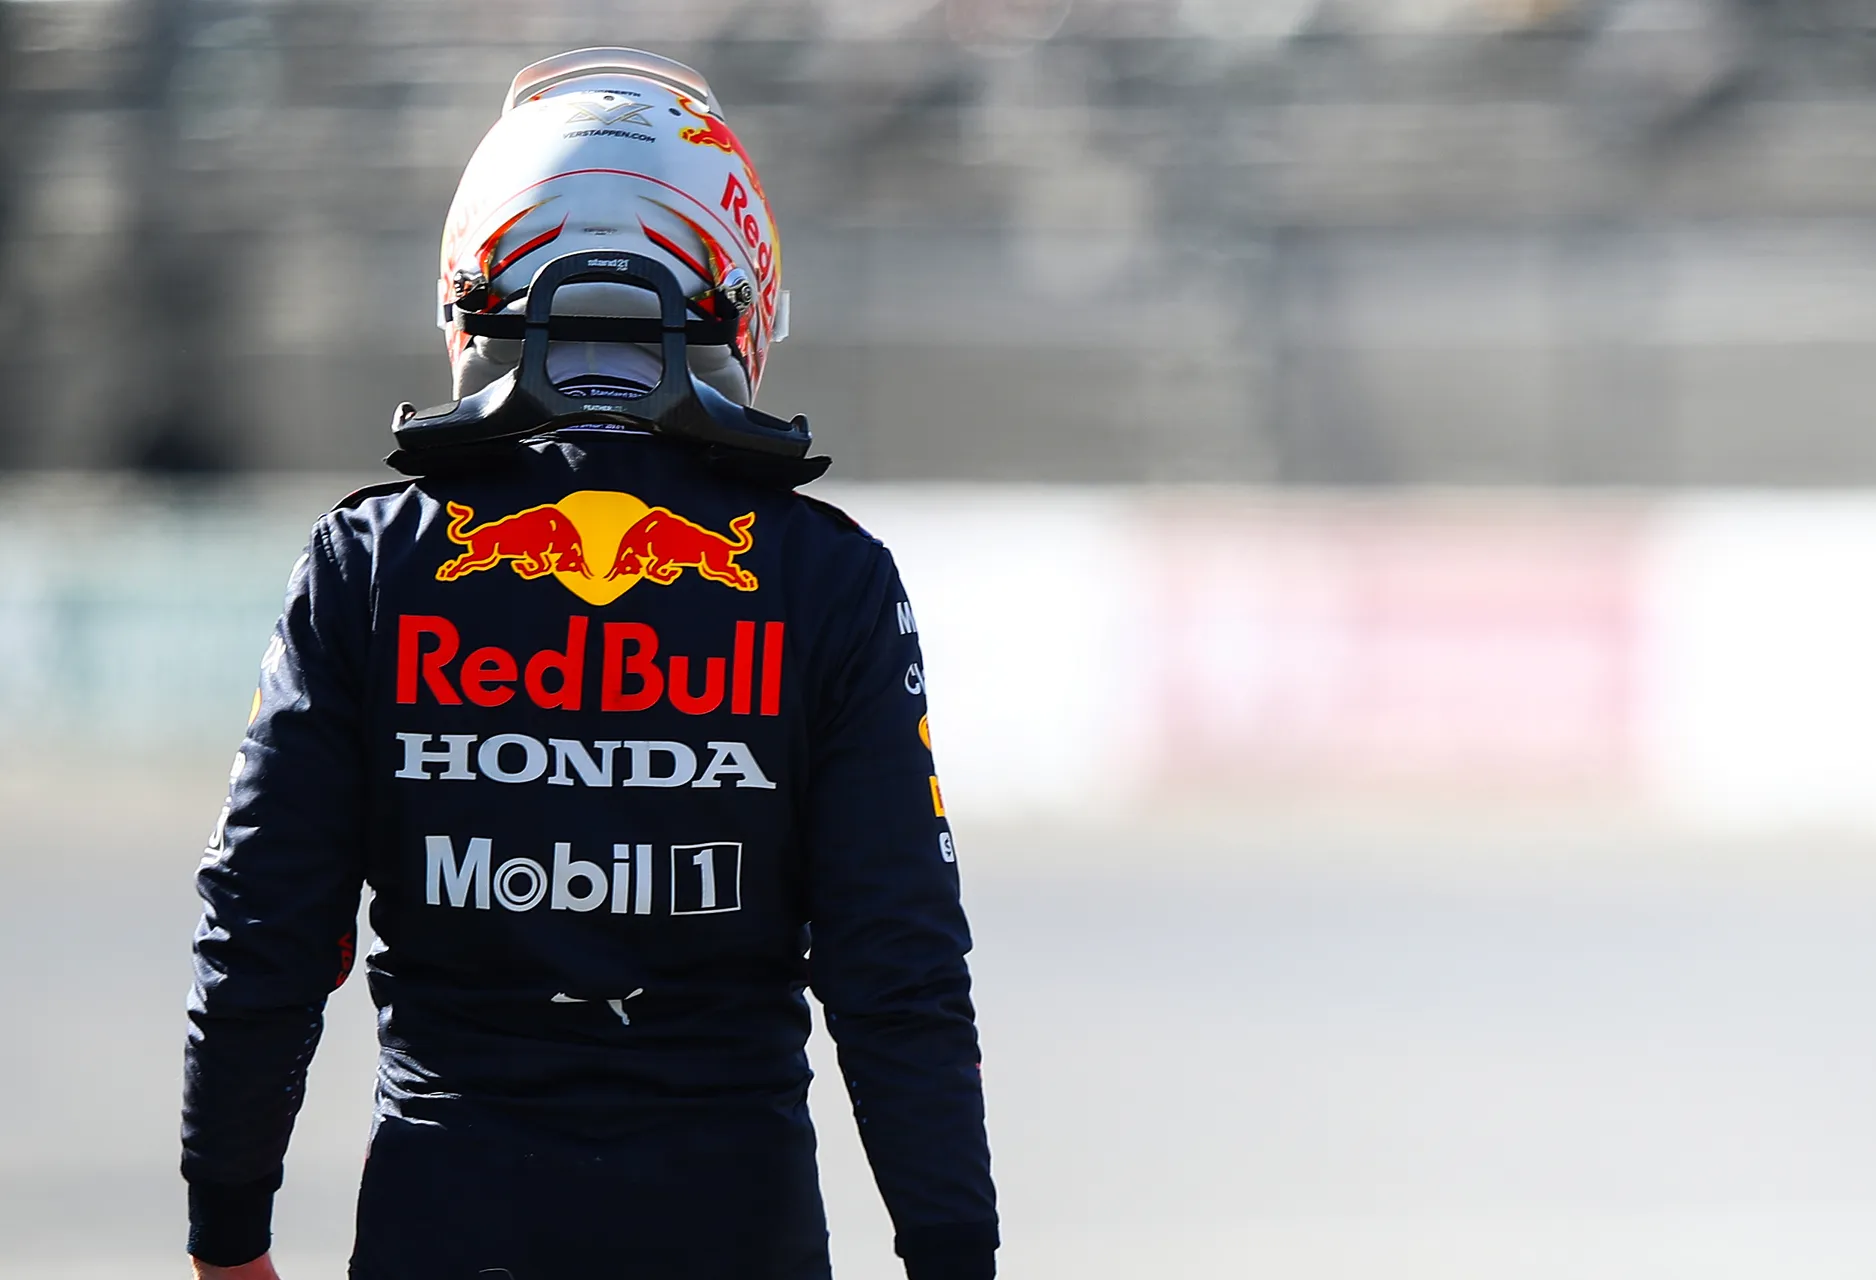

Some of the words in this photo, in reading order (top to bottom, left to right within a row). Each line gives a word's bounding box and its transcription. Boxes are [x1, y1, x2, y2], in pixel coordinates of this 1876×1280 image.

[563, 129, 656, 143] VERSTAPPEN.COM
[395, 732, 777, 789] HONDA
[425, 835, 653, 915] Mobil
